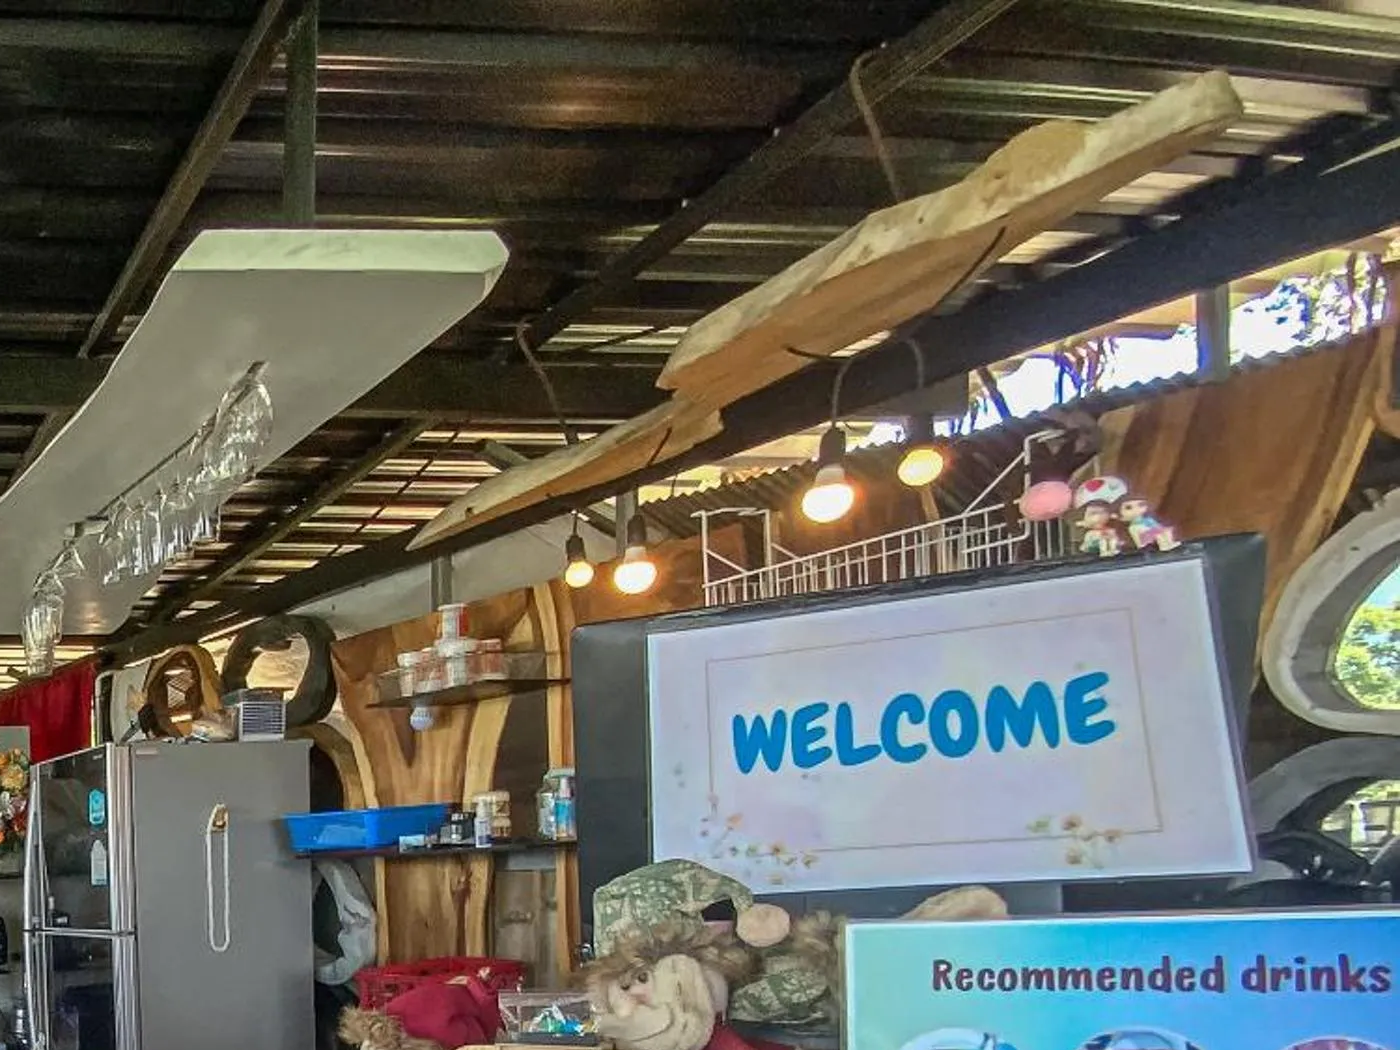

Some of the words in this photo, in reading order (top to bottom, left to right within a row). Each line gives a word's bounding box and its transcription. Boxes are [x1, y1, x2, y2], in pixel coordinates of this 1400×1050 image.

[732, 671, 1116, 774] WELCOME
[932, 954, 1225, 994] Recommended
[1241, 953, 1392, 994] drinks
